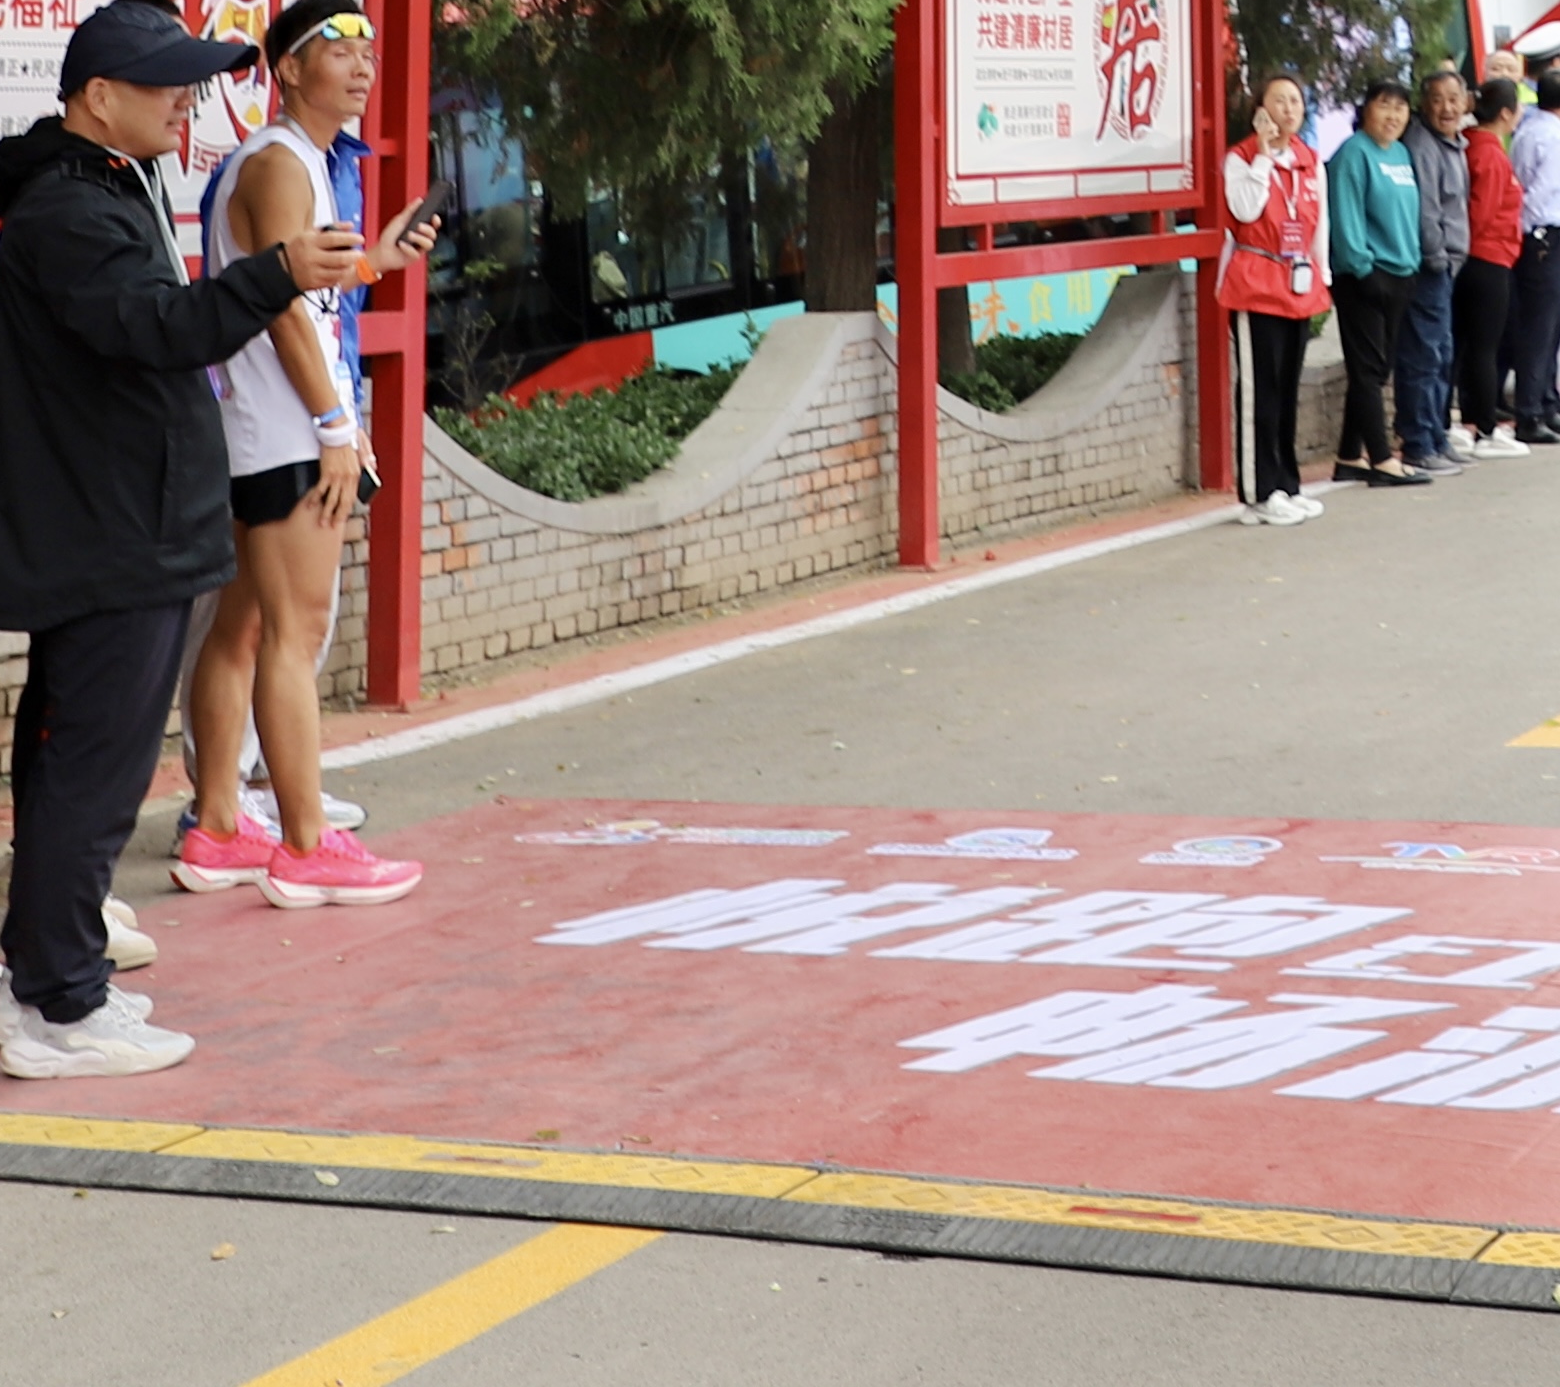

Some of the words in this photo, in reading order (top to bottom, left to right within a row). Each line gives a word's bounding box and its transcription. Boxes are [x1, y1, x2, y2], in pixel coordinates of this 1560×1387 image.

[976, 12, 1074, 51] 共建清廉村居
